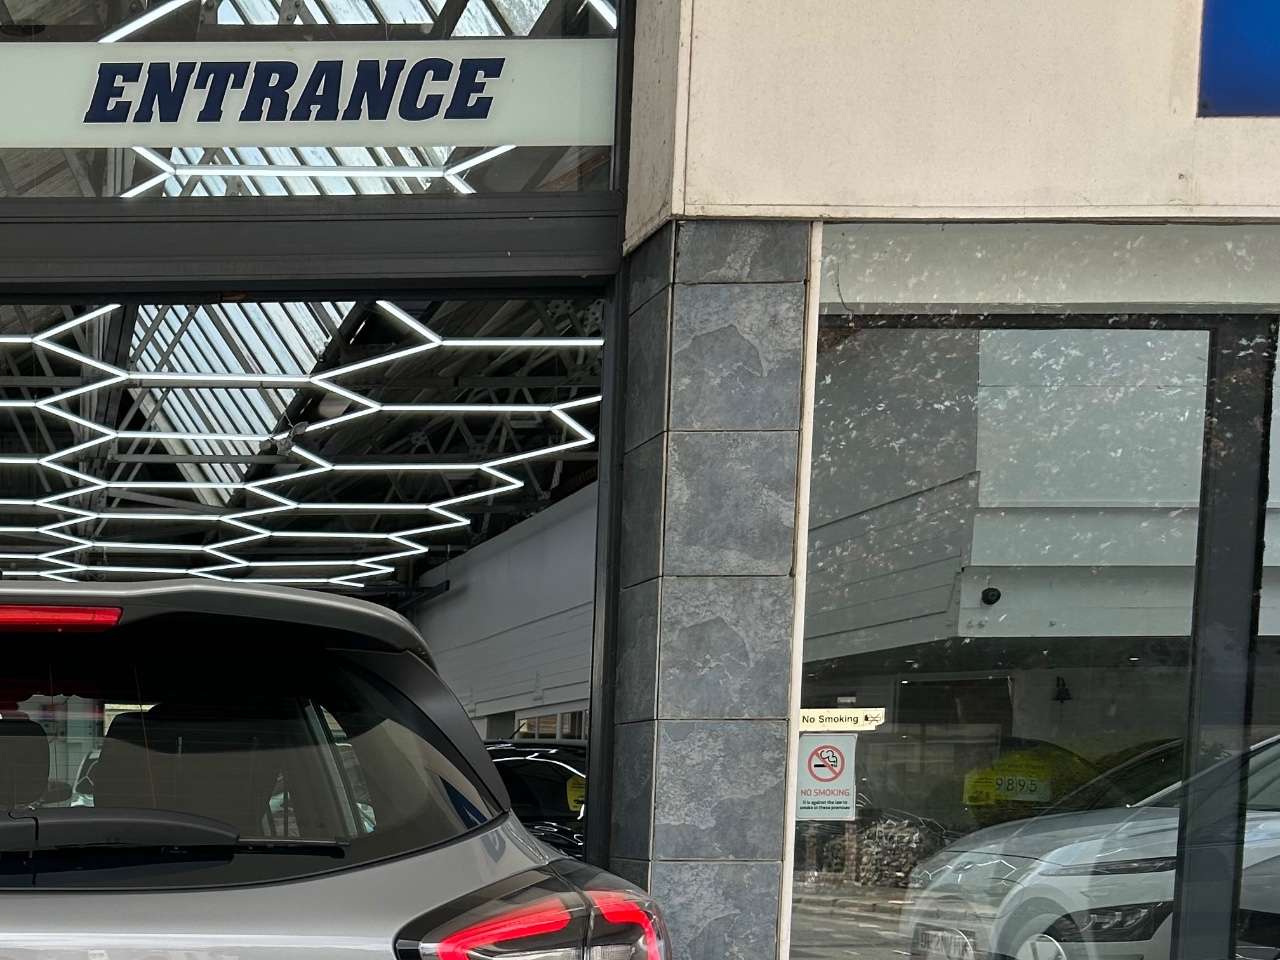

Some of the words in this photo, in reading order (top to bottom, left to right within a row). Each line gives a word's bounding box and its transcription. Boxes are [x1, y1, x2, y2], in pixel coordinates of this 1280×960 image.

[83, 56, 507, 124] ENTRANCE
[802, 715, 816, 724] No
[818, 715, 859, 725] Smoking
[995, 776, 1038, 793] 9895
[800, 788, 812, 797] NO
[813, 788, 850, 797] SMOKING
